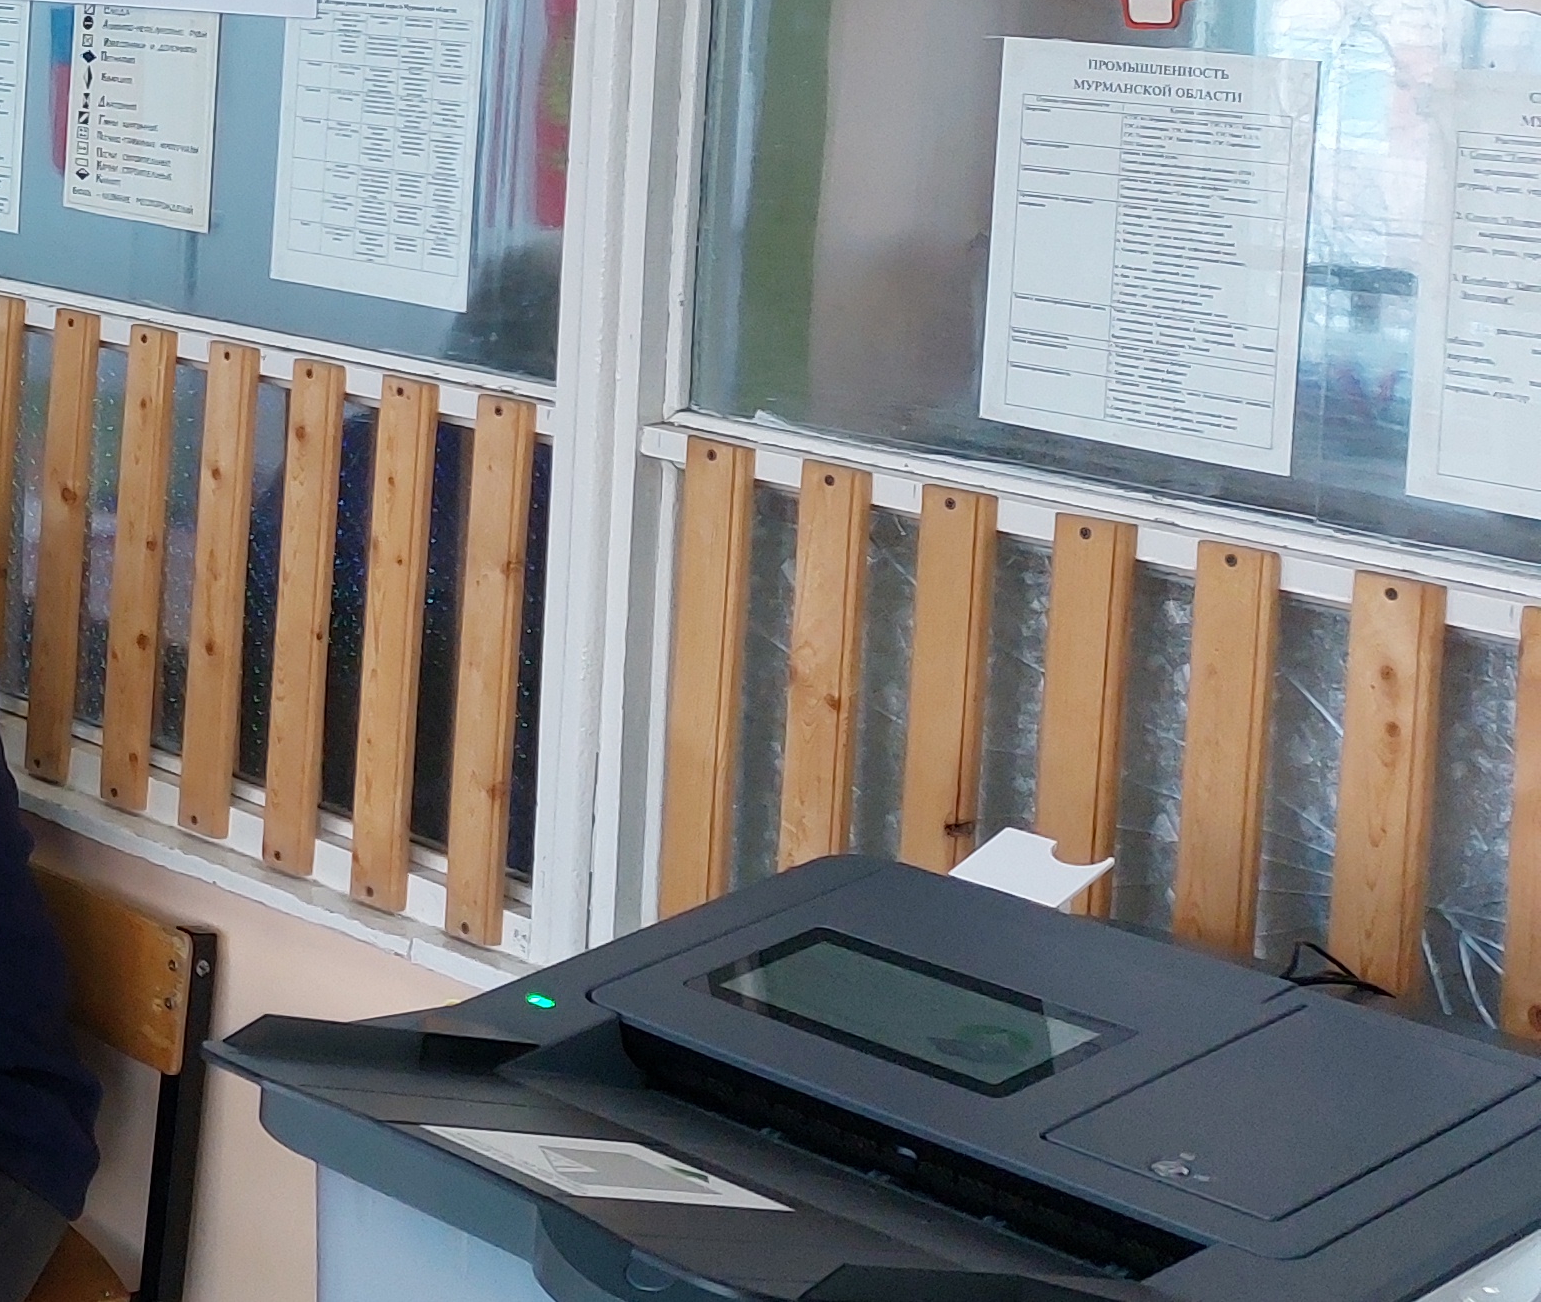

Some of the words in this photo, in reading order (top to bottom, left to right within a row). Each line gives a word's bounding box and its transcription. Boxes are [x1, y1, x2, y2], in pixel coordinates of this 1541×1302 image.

[1088, 58, 1230, 81] ПРОМЫШЛЕННОСТЬ
[1073, 78, 1173, 98] МУРМАНСКОЙ
[1175, 87, 1243, 103] ОБЛАСТИ
